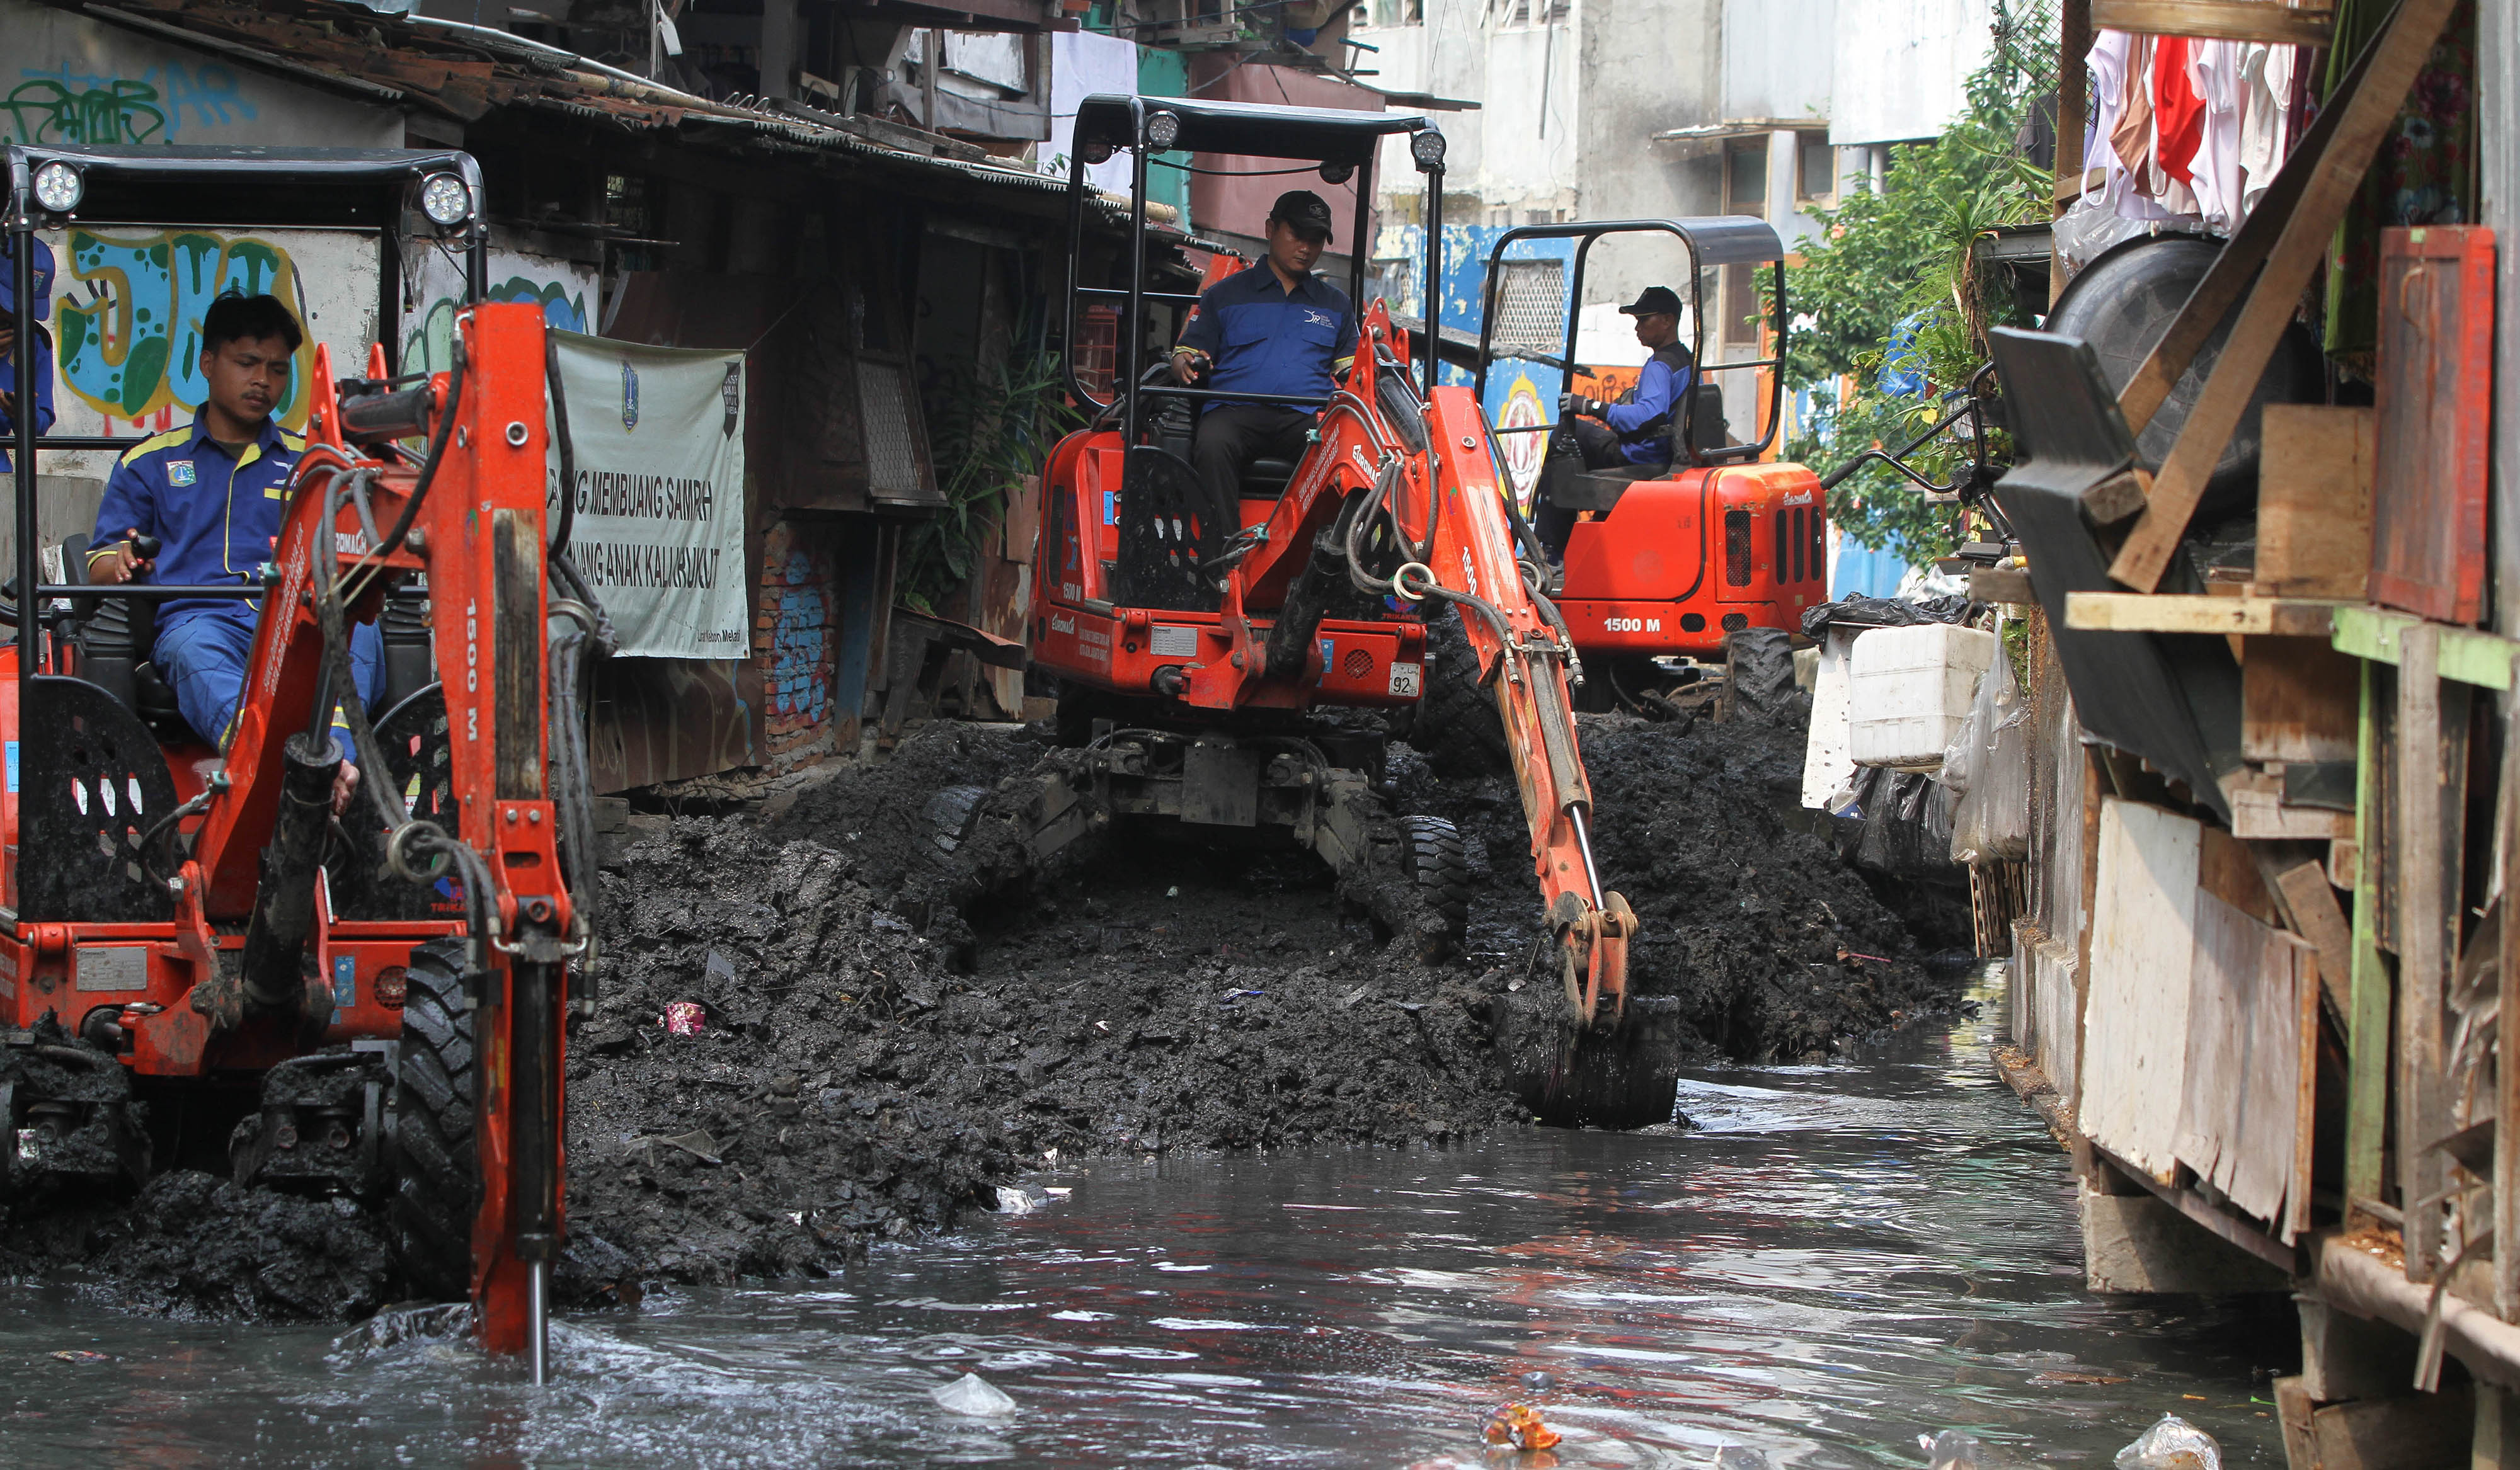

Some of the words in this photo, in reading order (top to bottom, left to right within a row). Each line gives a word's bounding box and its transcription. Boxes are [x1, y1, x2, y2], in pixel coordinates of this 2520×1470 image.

[1352, 444, 1382, 485] EUROMAC
[590, 471, 662, 519] MEMBUANG
[336, 528, 367, 556] ROMACH
[607, 543, 642, 588] ANAK
[1462, 545, 1477, 596] 1500
[1063, 582, 1075, 600] 1500
[1075, 585, 1082, 603] M
[722, 629, 740, 642] Melati
[1603, 618, 1642, 632] 1500
[1646, 618, 1661, 632] M
[1393, 676, 1409, 693] 92
